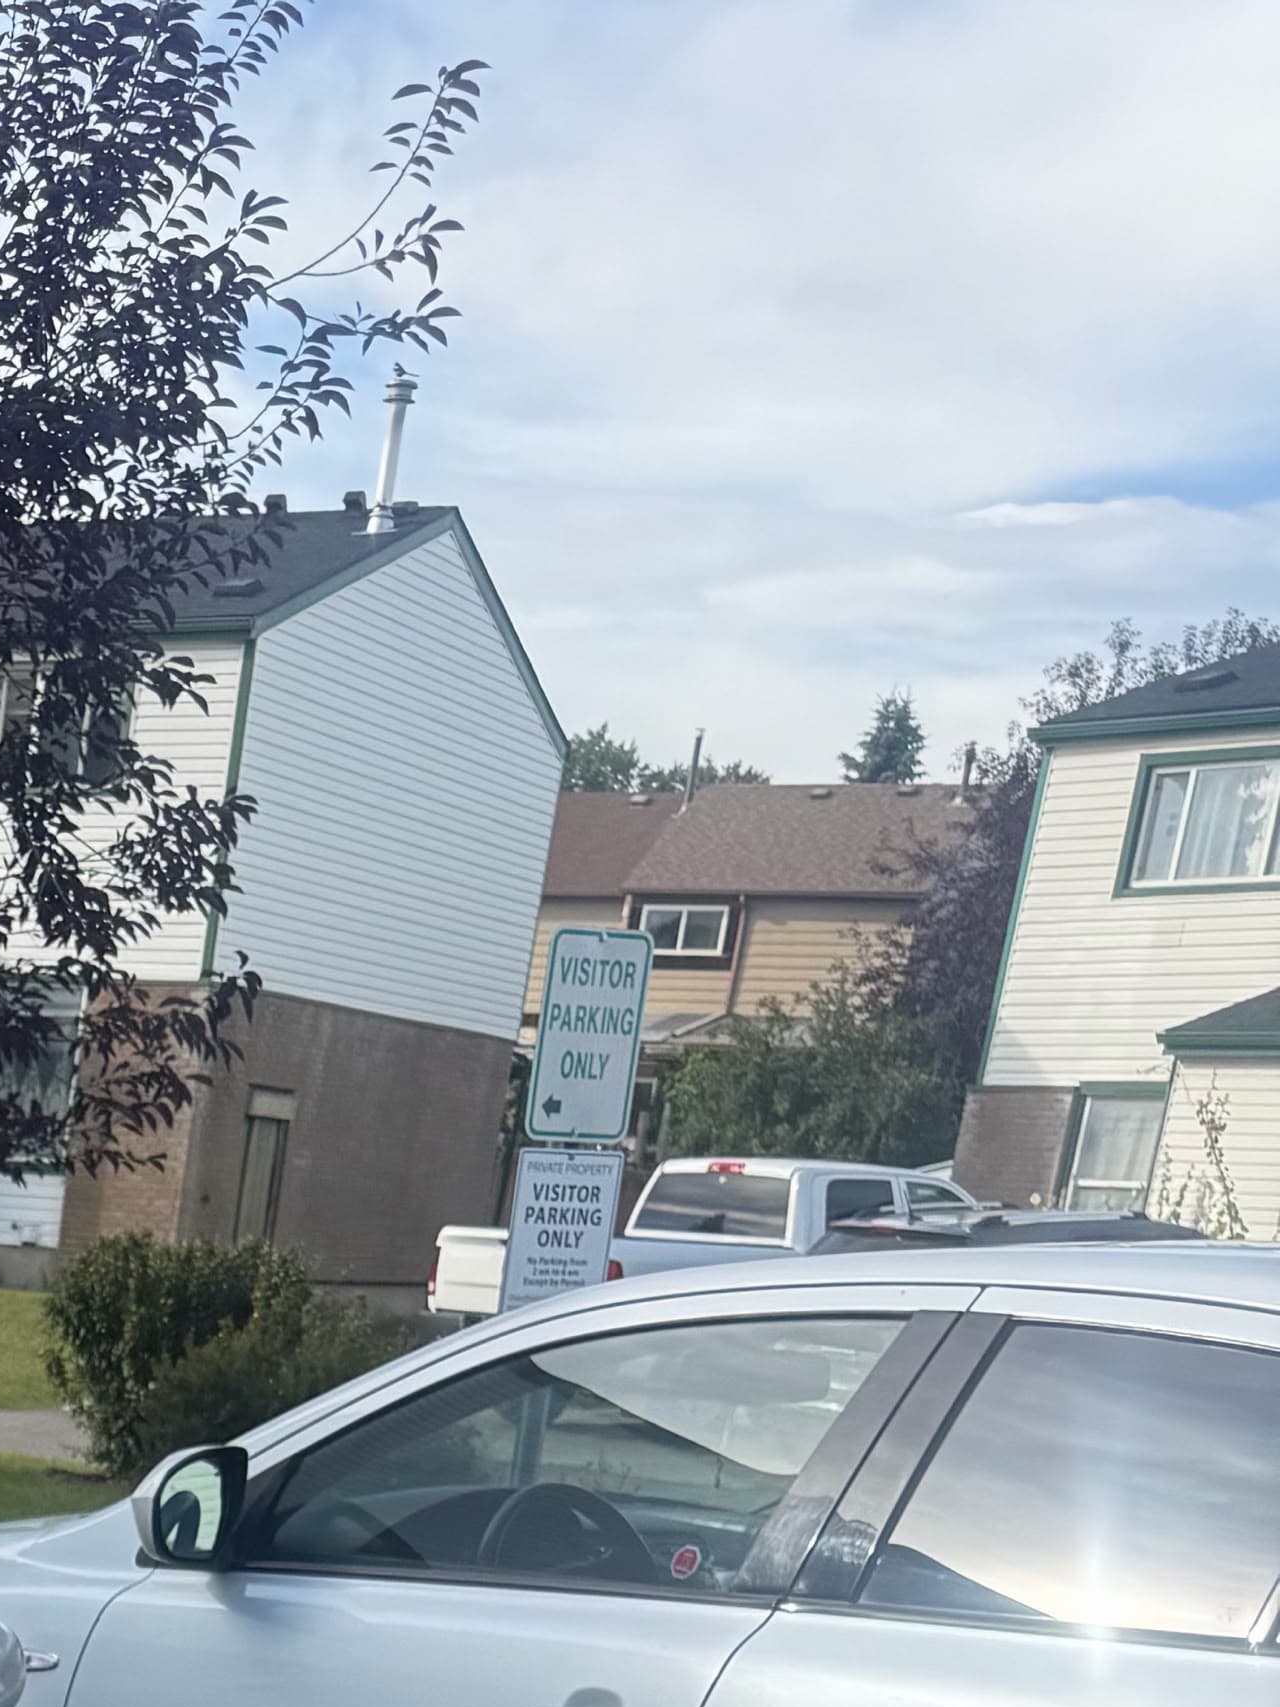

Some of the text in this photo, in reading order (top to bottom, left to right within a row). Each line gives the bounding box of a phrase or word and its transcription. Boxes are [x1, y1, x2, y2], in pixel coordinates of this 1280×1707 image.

[560, 956, 637, 989] VISITOR
[548, 1003, 634, 1036] PARKING
[560, 1050, 611, 1080] ONLY
[526, 1161, 614, 1177] PRIVATE PROPERTY
[533, 1182, 601, 1204] VISITOR
[524, 1206, 602, 1226] PARKING
[537, 1230, 584, 1249] ONLY
[539, 1257, 567, 1267] Parking
